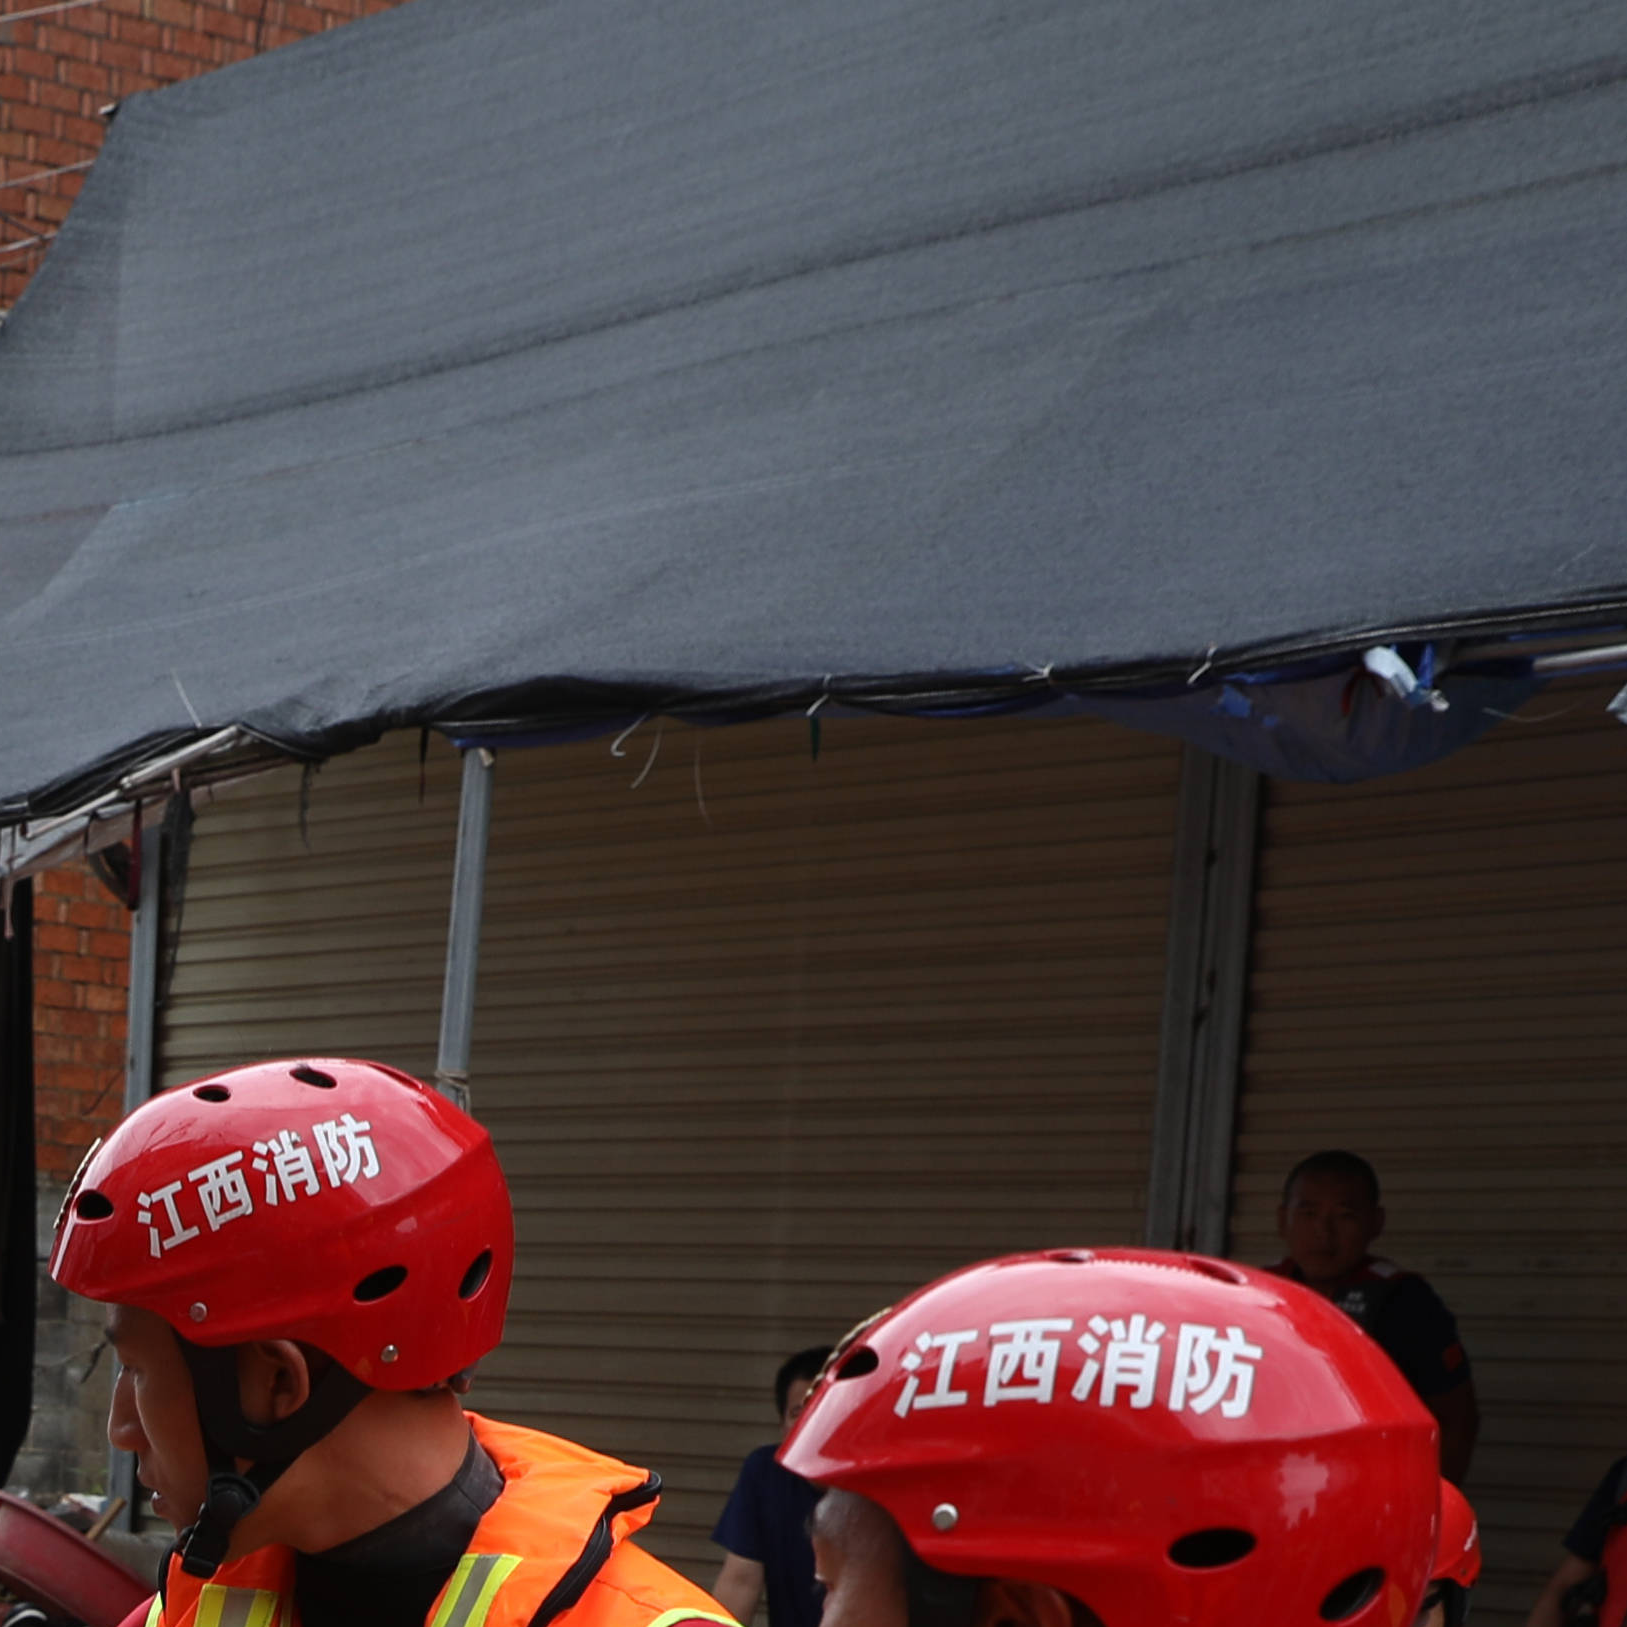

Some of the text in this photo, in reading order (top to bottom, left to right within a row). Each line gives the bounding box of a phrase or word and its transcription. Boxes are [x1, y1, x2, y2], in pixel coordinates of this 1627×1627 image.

[136, 1112, 381, 1259] 江西消防
[893, 1313, 1263, 1418] 江西消防
